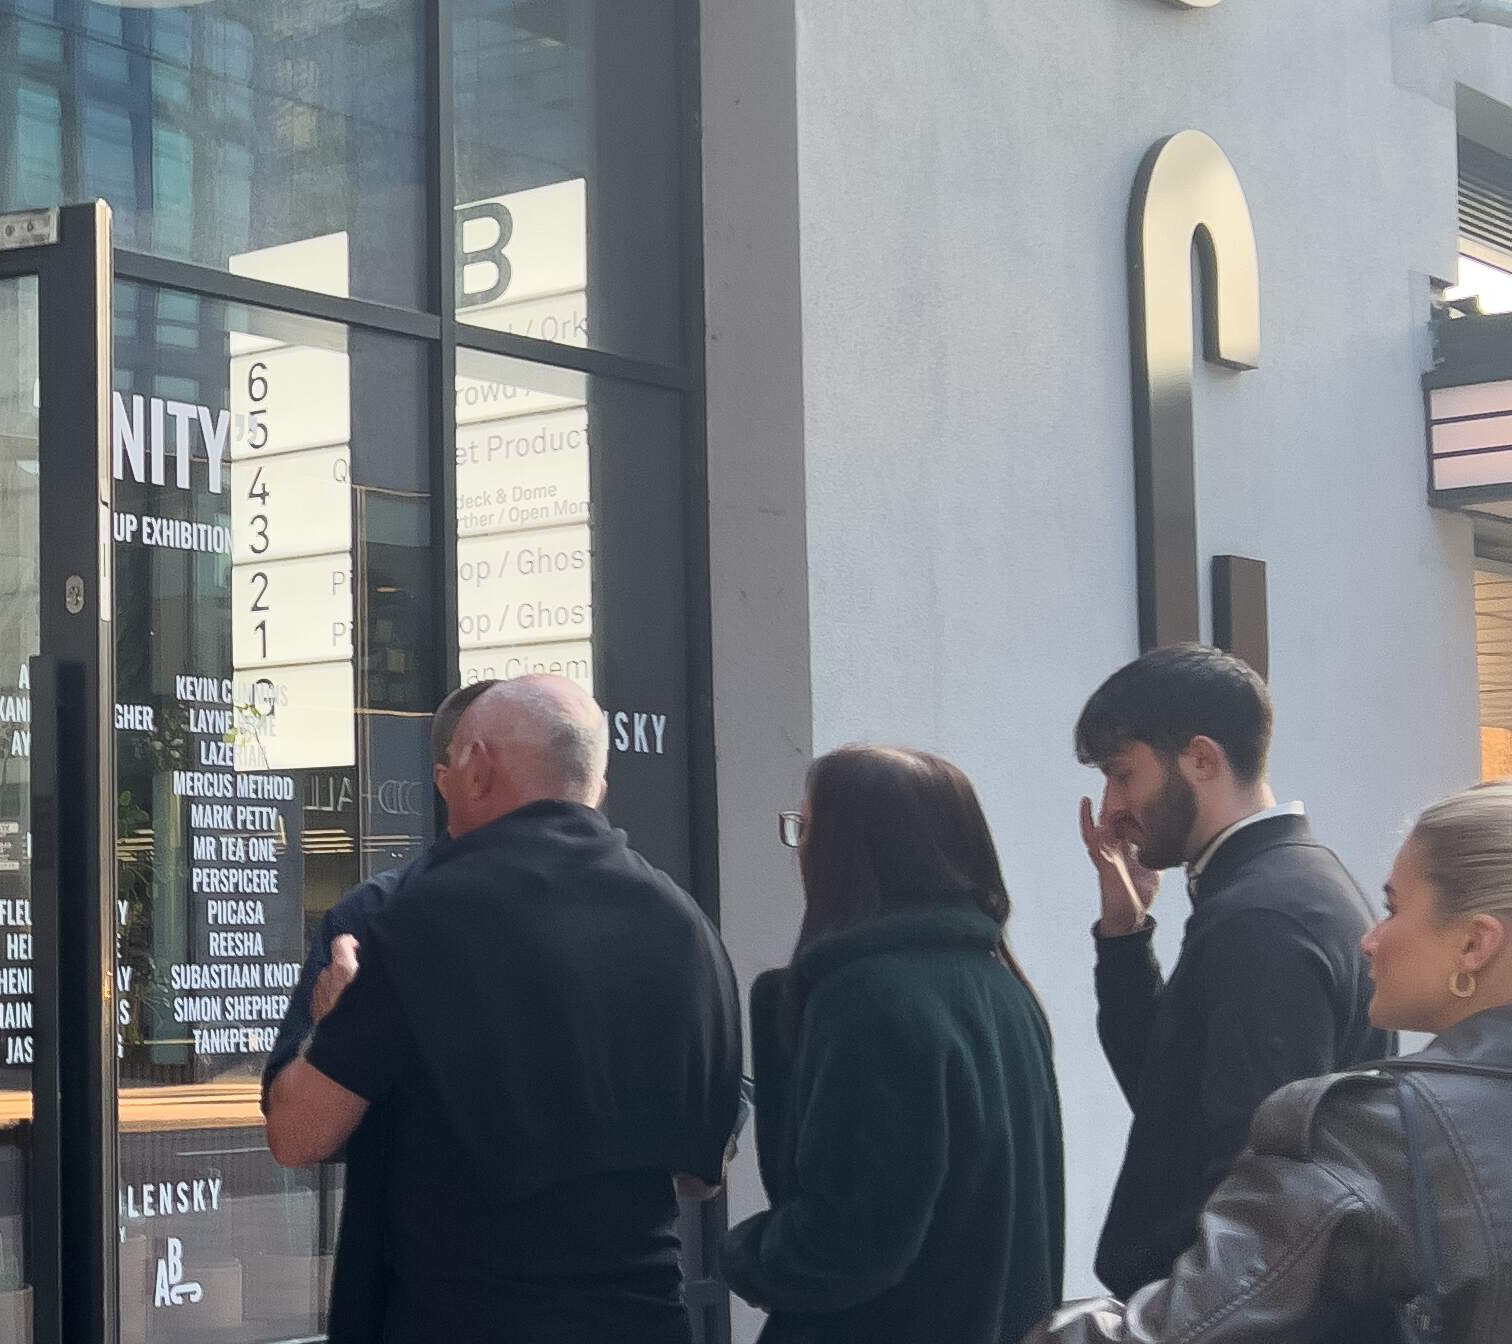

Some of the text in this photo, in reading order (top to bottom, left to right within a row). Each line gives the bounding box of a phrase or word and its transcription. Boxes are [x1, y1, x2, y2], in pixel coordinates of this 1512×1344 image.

[247, 362, 269, 402] 6
[247, 409, 269, 450] 5
[248, 465, 270, 506] 4
[113, 512, 233, 556] UP EXHIBITION
[248, 514, 270, 554] 3
[516, 547, 591, 576] Ghos
[250, 571, 271, 612] 2
[516, 602, 589, 630] Ghos
[253, 619, 268, 659] 1
[175, 674, 220, 703] KEVIN
[604, 709, 668, 756] SKY
[173, 770, 294, 801] MERCUS METHOD
[191, 803, 279, 831] MARK PETTY
[193, 835, 278, 863] MR TEA ONE
[192, 867, 280, 894] PERSPICERE
[207, 899, 266, 925] PIICASA
[209, 931, 265, 956] REESHA
[170, 963, 261, 990] SUBASTIAAN
[173, 996, 223, 1023] SIMON
[192, 1026, 279, 1055] TANKPETRO
[119, 1177, 222, 1218] LENSKY
